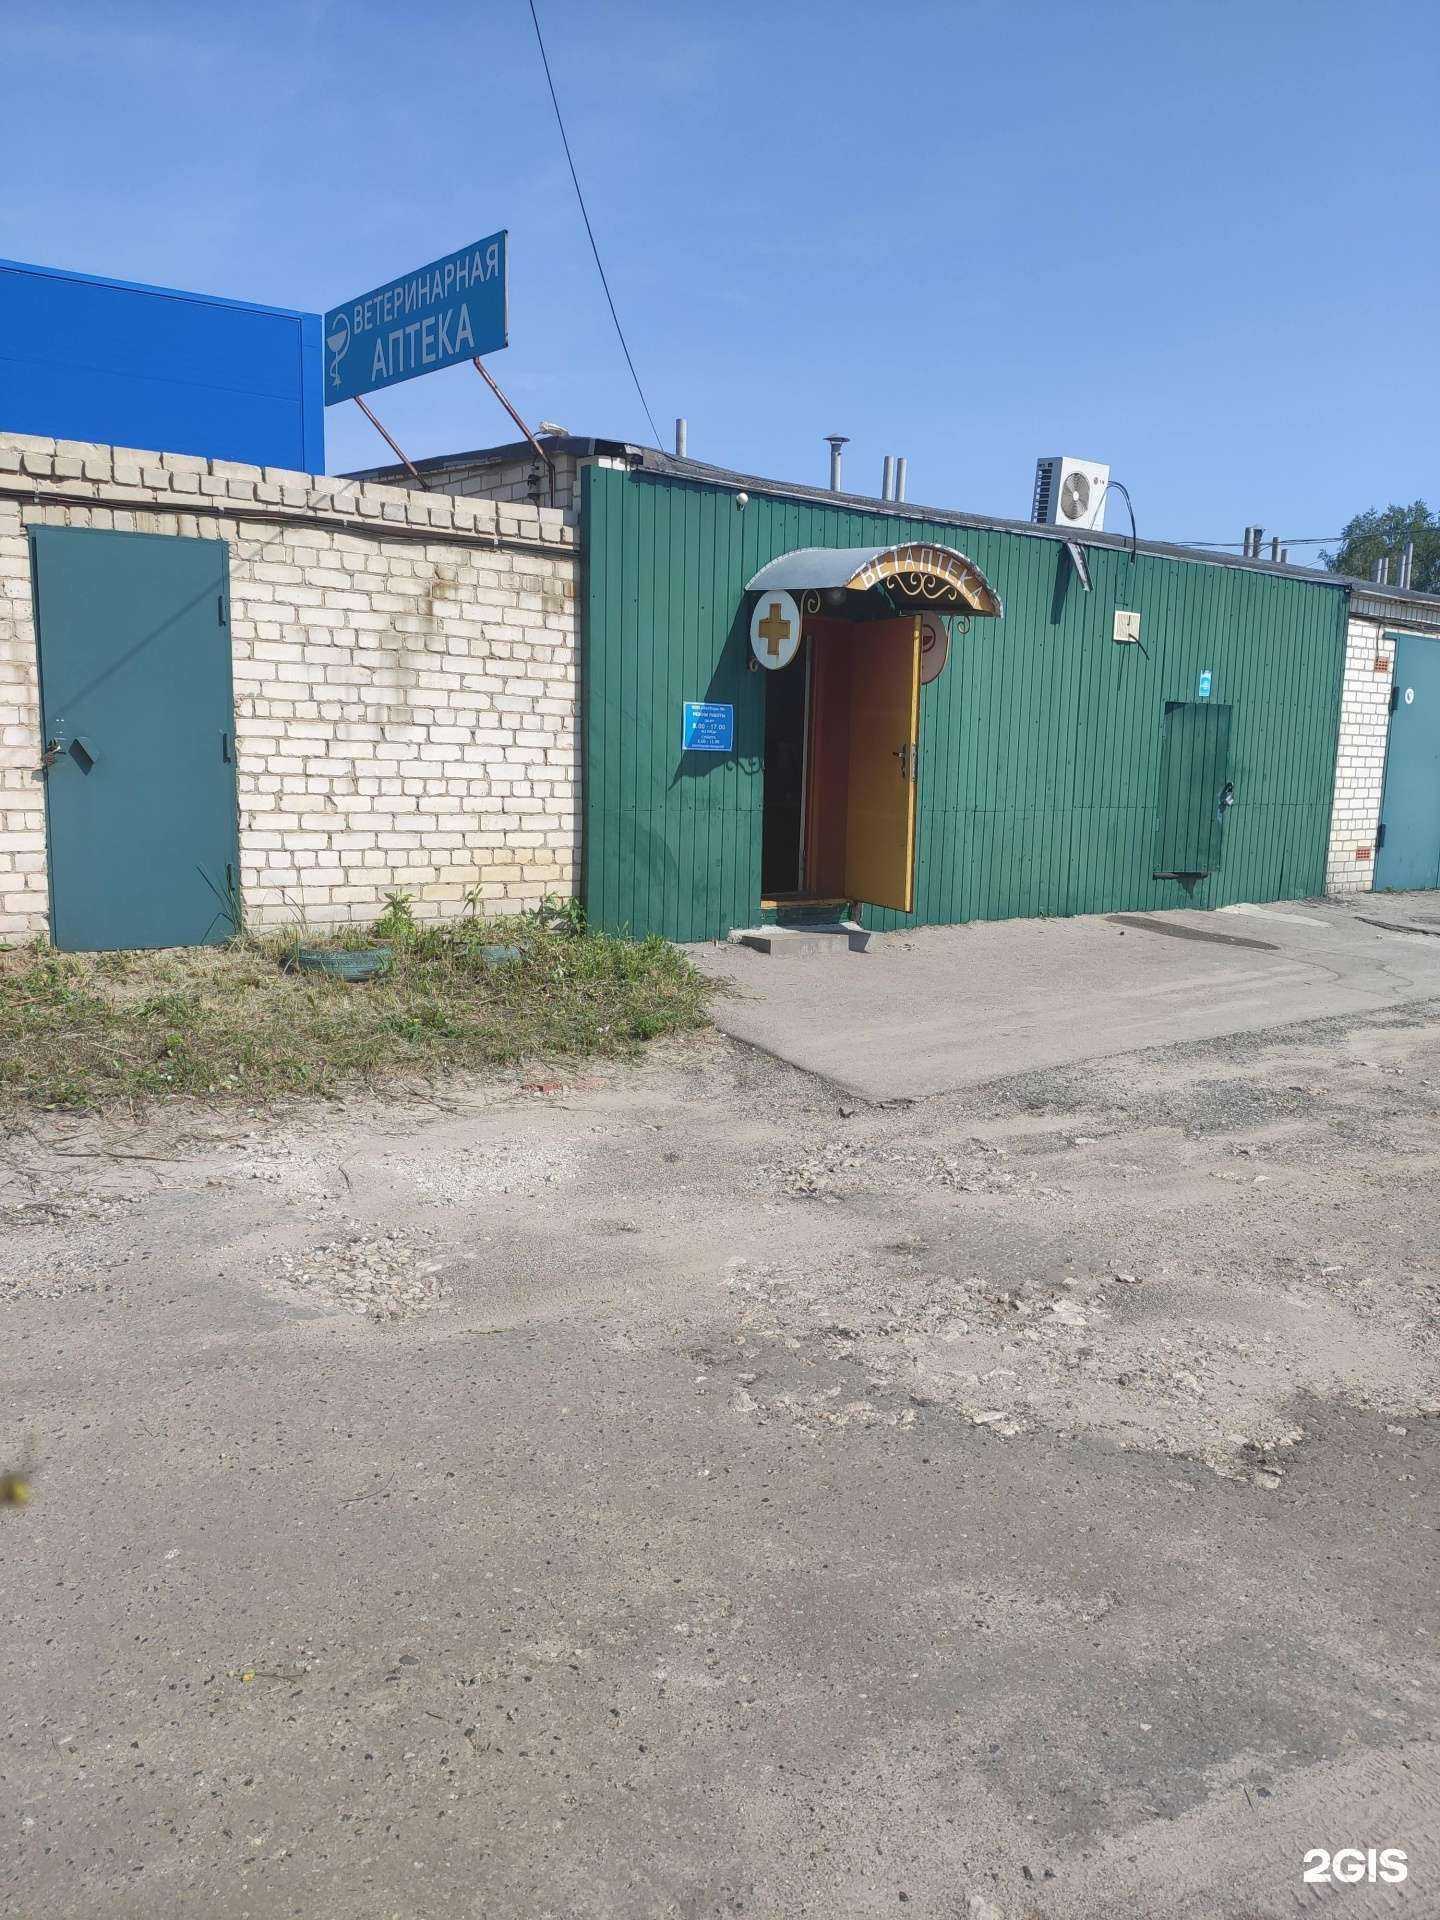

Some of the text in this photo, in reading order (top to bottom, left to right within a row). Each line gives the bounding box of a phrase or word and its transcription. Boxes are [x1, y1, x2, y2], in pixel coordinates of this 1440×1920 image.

[353, 242, 499, 335] ВЕТЕРИНАРНАЯ
[371, 303, 475, 382] АПТЕКА
[860, 546, 983, 610] ВЕТАПТЕКА
